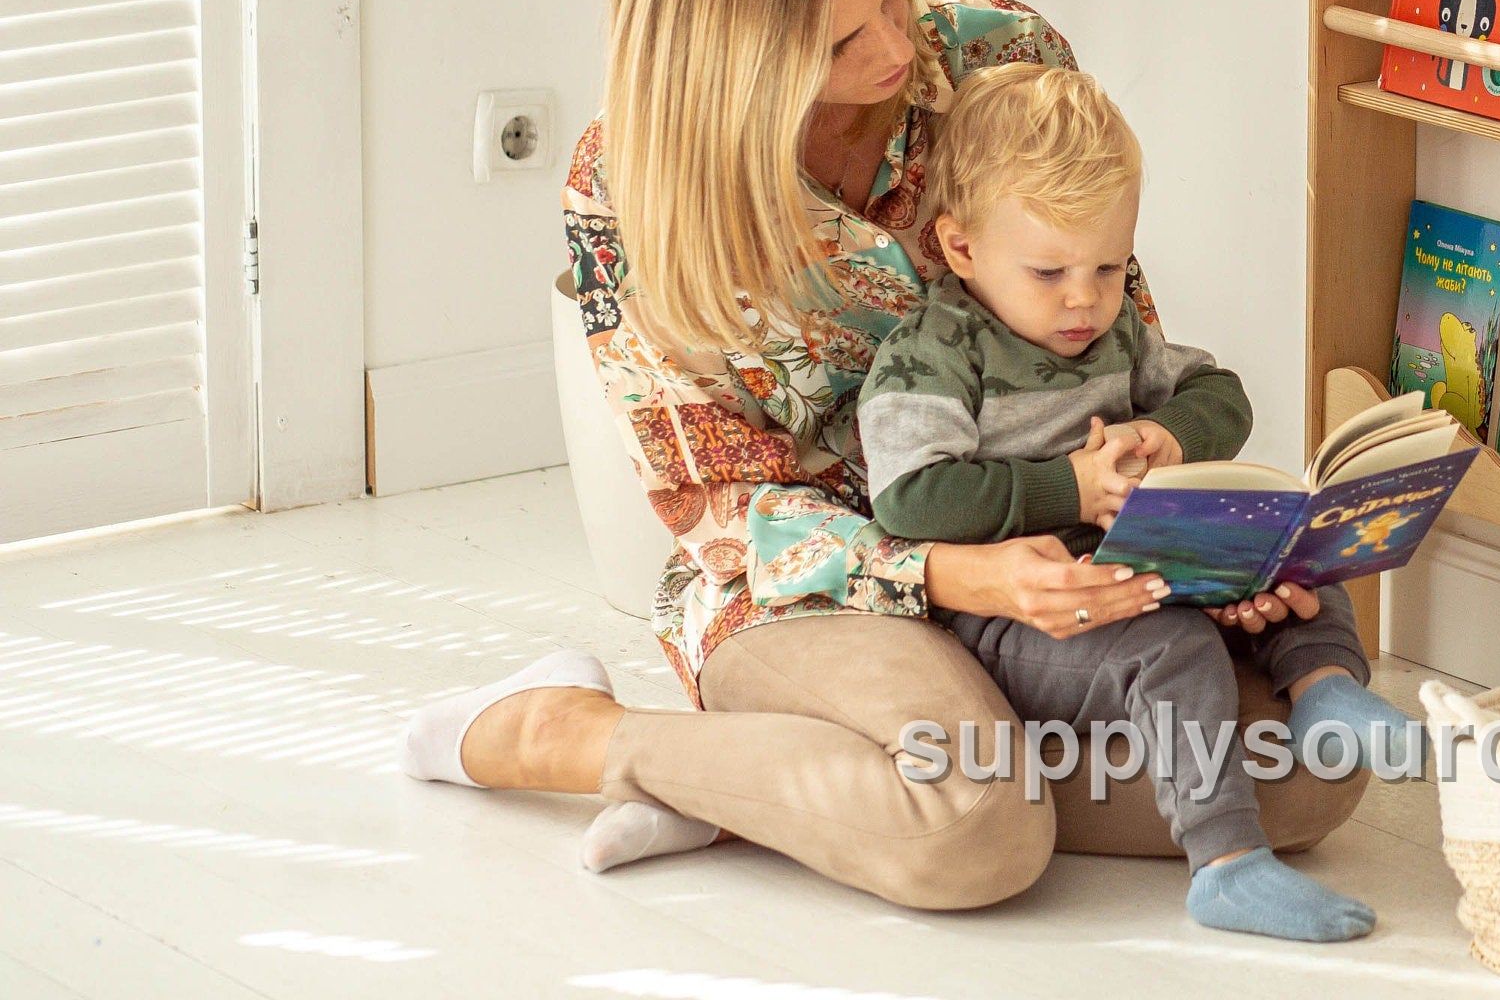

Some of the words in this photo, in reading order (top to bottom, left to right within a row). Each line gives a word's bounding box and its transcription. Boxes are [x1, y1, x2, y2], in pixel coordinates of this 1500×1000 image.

[1415, 246, 1440, 272] Чому
[1442, 258, 1454, 272] не
[1455, 259, 1492, 283] літають
